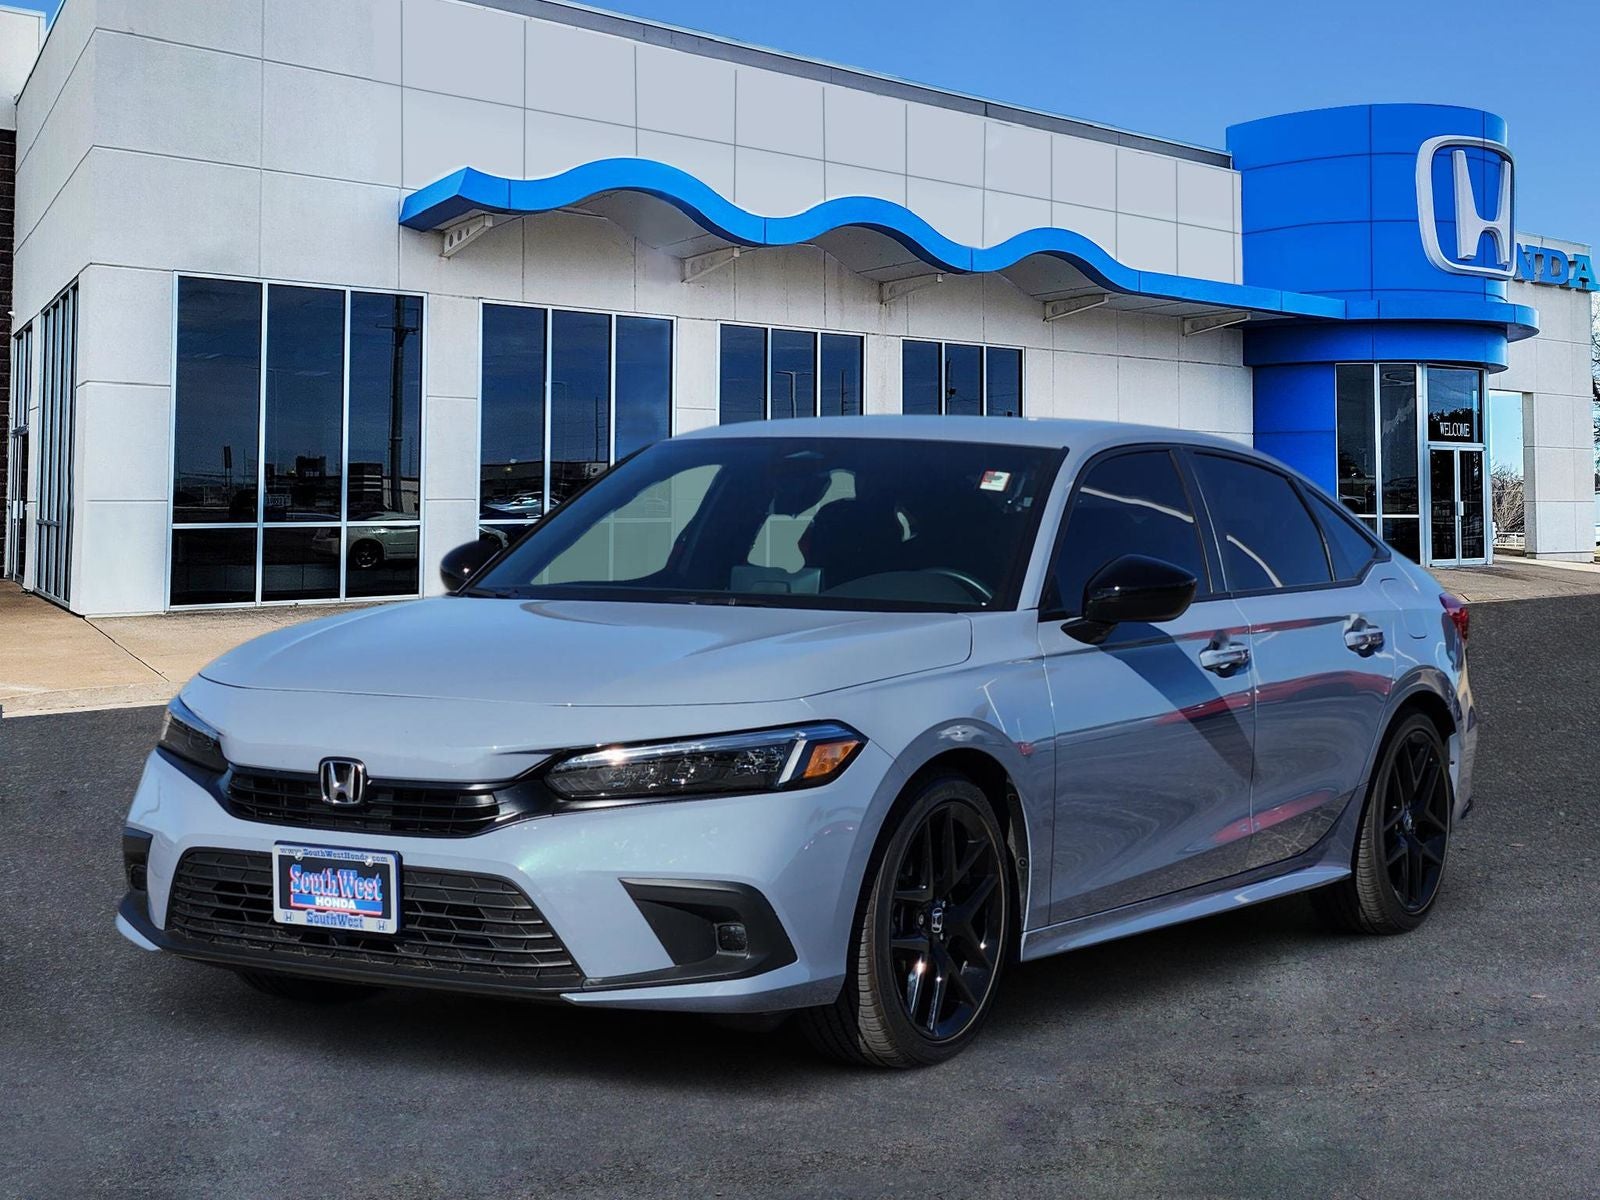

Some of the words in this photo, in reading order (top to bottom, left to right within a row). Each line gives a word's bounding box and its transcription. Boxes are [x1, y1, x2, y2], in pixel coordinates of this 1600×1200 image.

[1513, 243, 1600, 291] NDA
[1439, 422, 1470, 437] WELCOME
[280, 848, 388, 862] wwwSouthWestHondacom
[315, 896, 357, 909] HONDA
[306, 911, 364, 928] SouthWest
